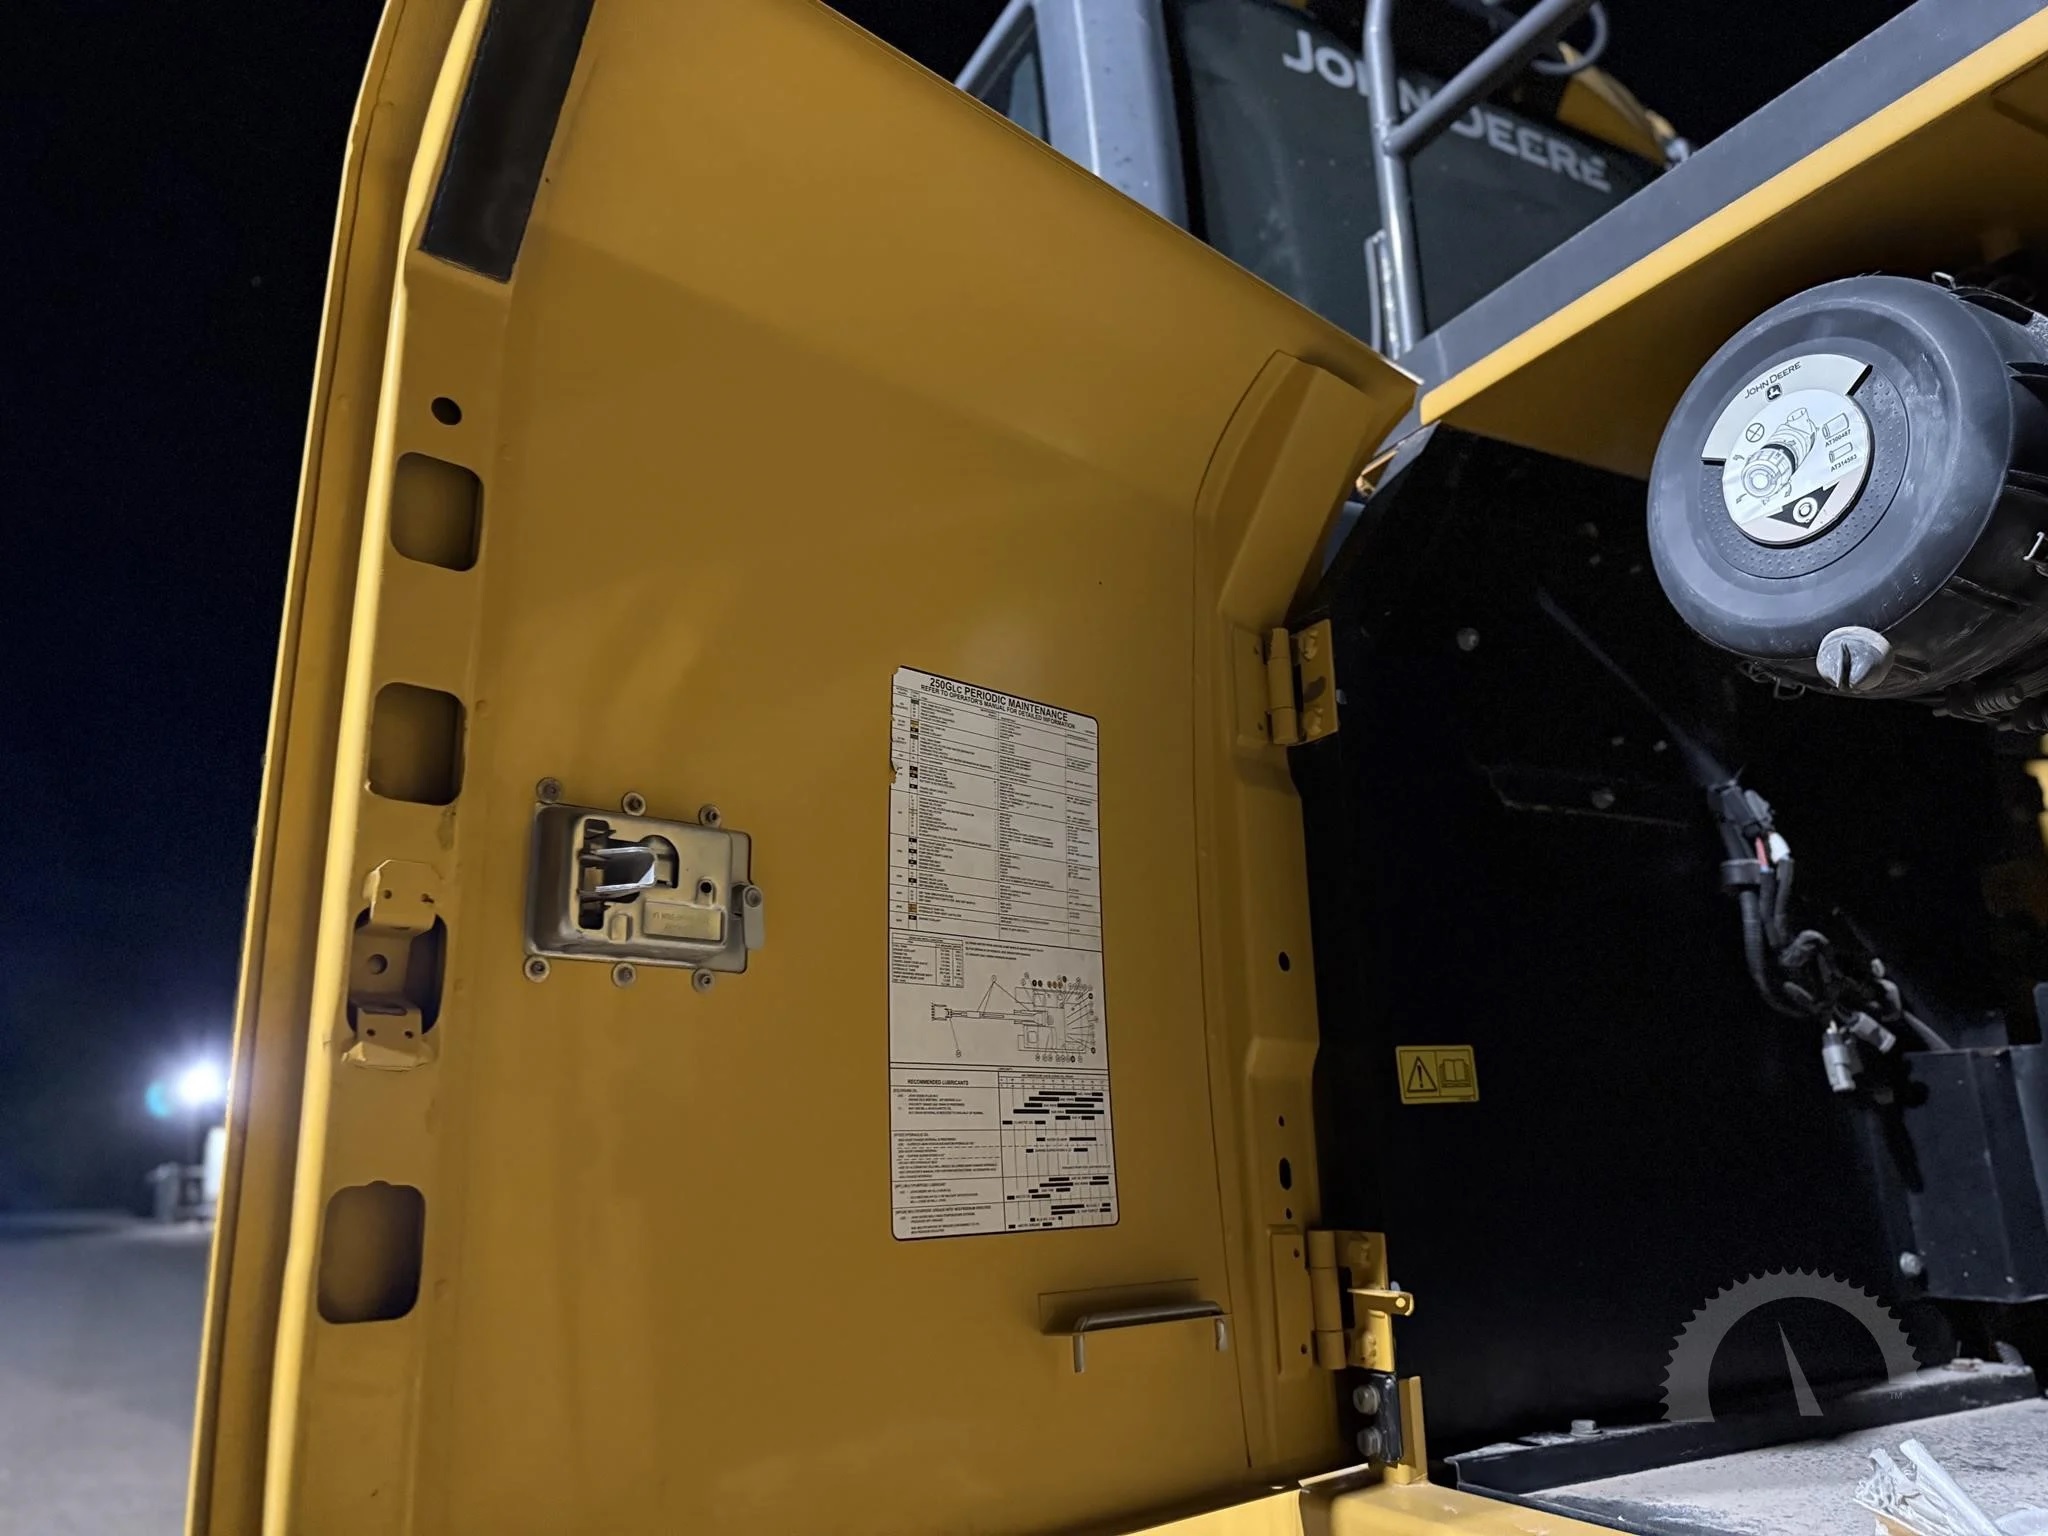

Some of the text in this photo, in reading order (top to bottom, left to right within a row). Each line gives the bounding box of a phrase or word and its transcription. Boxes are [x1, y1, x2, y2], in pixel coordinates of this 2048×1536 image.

[1744, 361, 1802, 399] JOHN DEERE
[920, 684, 940, 695] REFER
[941, 689, 949, 697] TO
[949, 692, 983, 706] OPERATOR'S
[983, 701, 1006, 712] MANUAL
[1006, 706, 1017, 716] FOR
[1018, 710, 1042, 721] DETAILED
[1042, 716, 1076, 729] INFORMATION
[964, 686, 1006, 706] PERIODIC
[1008, 698, 1068, 722] MAINTENANCE
